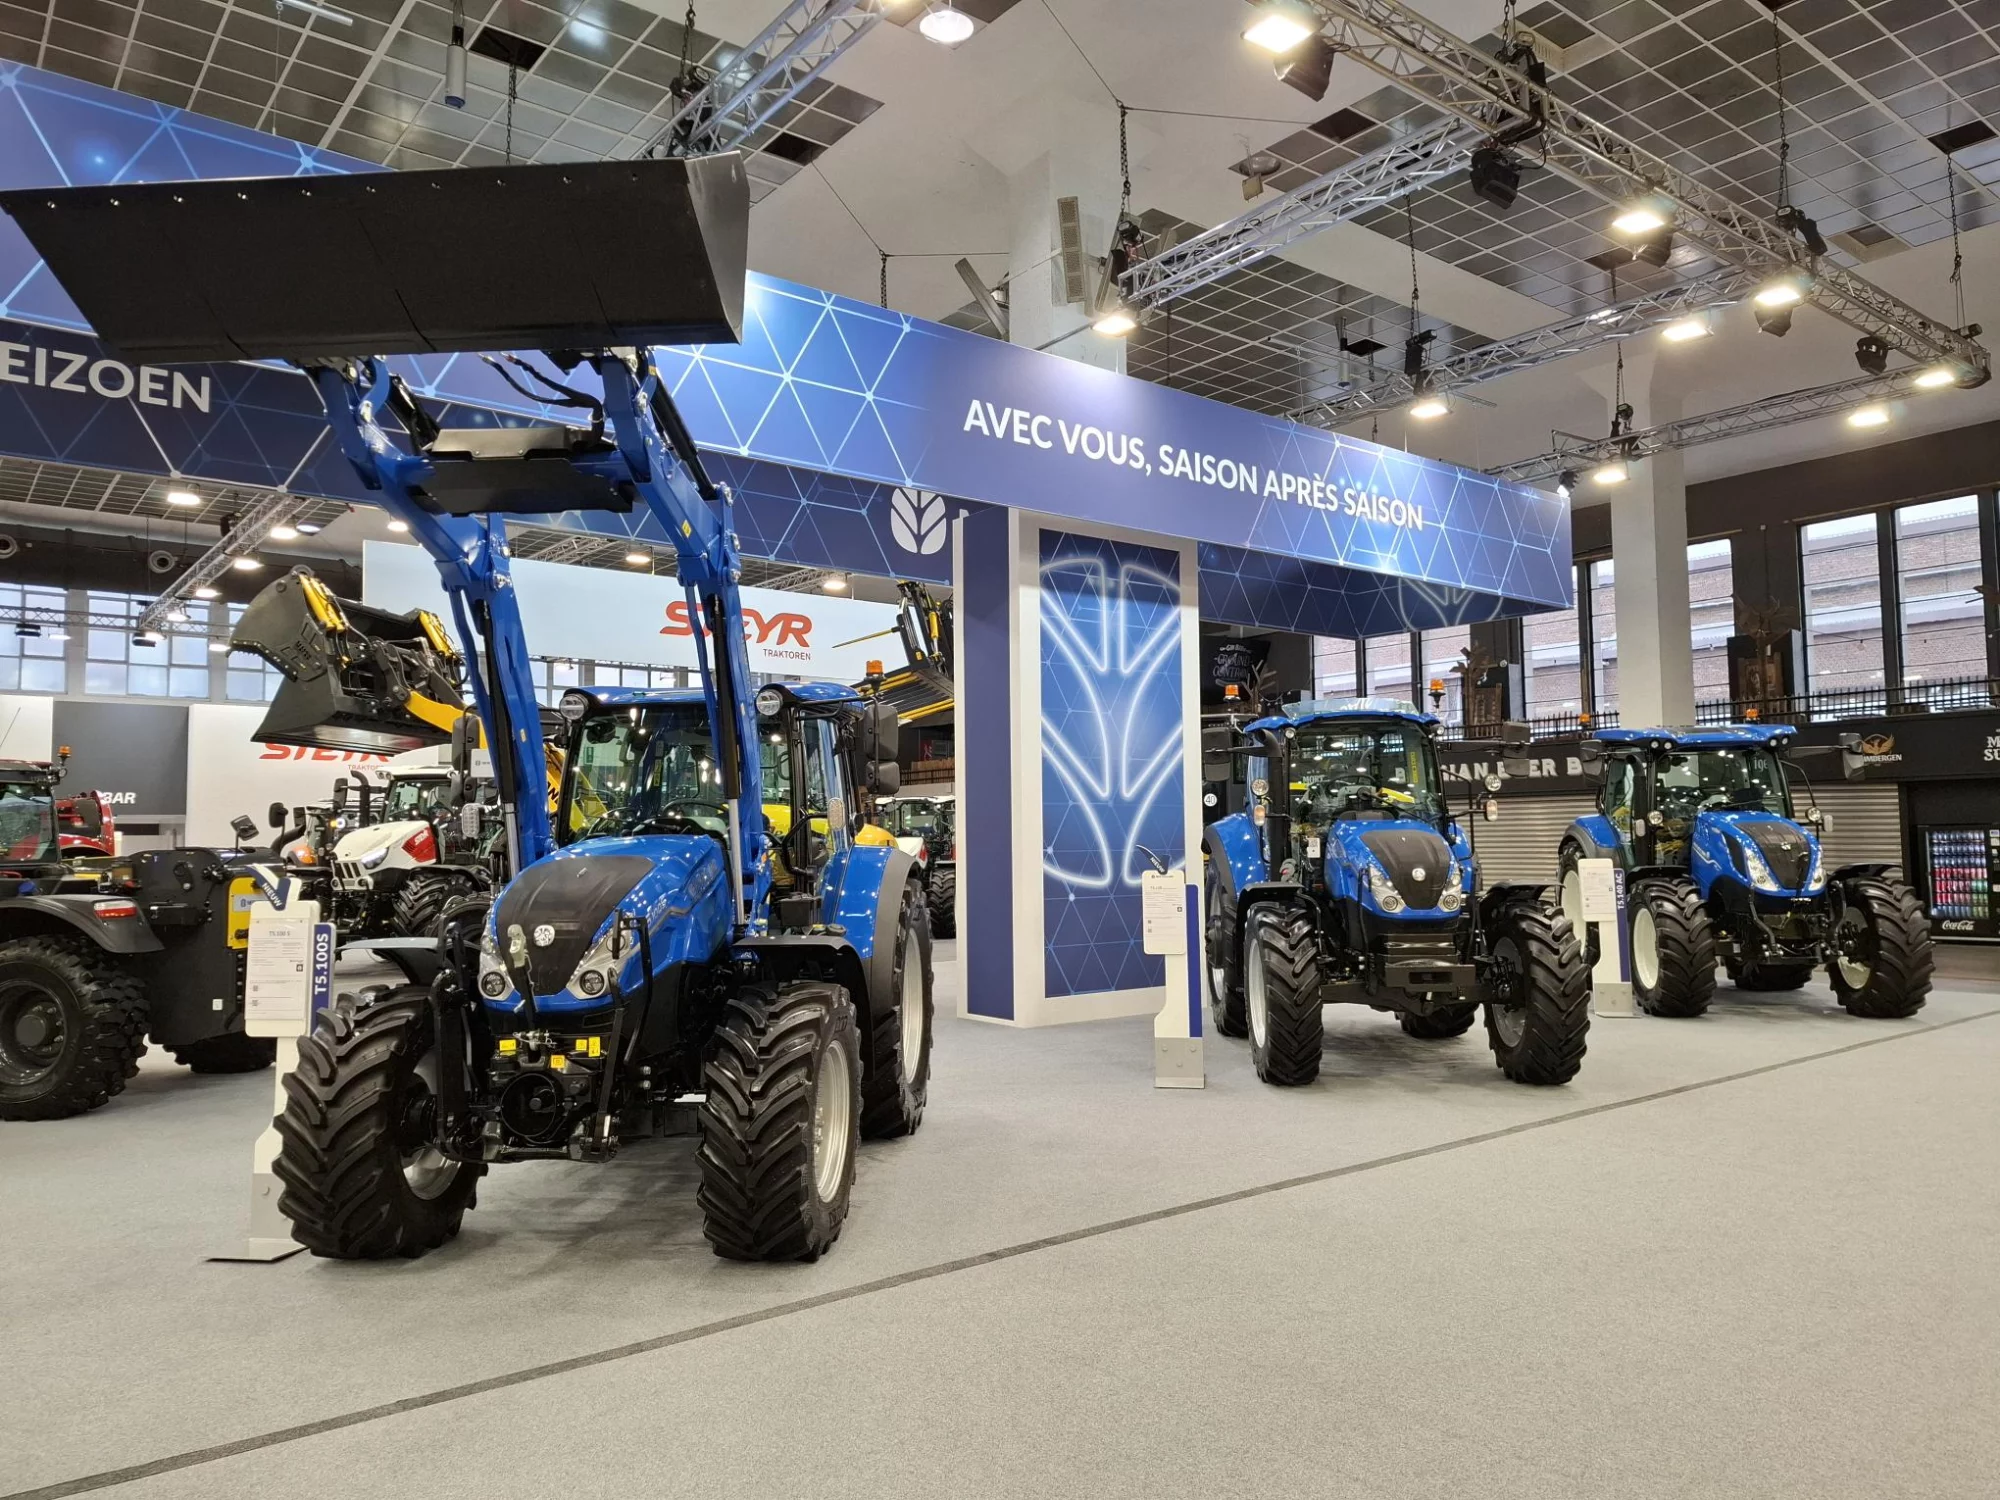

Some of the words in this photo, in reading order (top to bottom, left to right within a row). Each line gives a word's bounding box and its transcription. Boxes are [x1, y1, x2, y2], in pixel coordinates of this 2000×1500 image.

[963, 399, 1053, 449] AVEC
[1057, 419, 1152, 477] VOUS,
[1159, 444, 1258, 495] SAISON
[1263, 470, 1339, 512] APRÈS
[1343, 488, 1424, 531] SAISON
[763, 649, 811, 661] TRAKTOREN
[1205, 796, 1216, 805] 40
[261, 882, 283, 907] NIEUW
[314, 933, 329, 995] T5.100S
